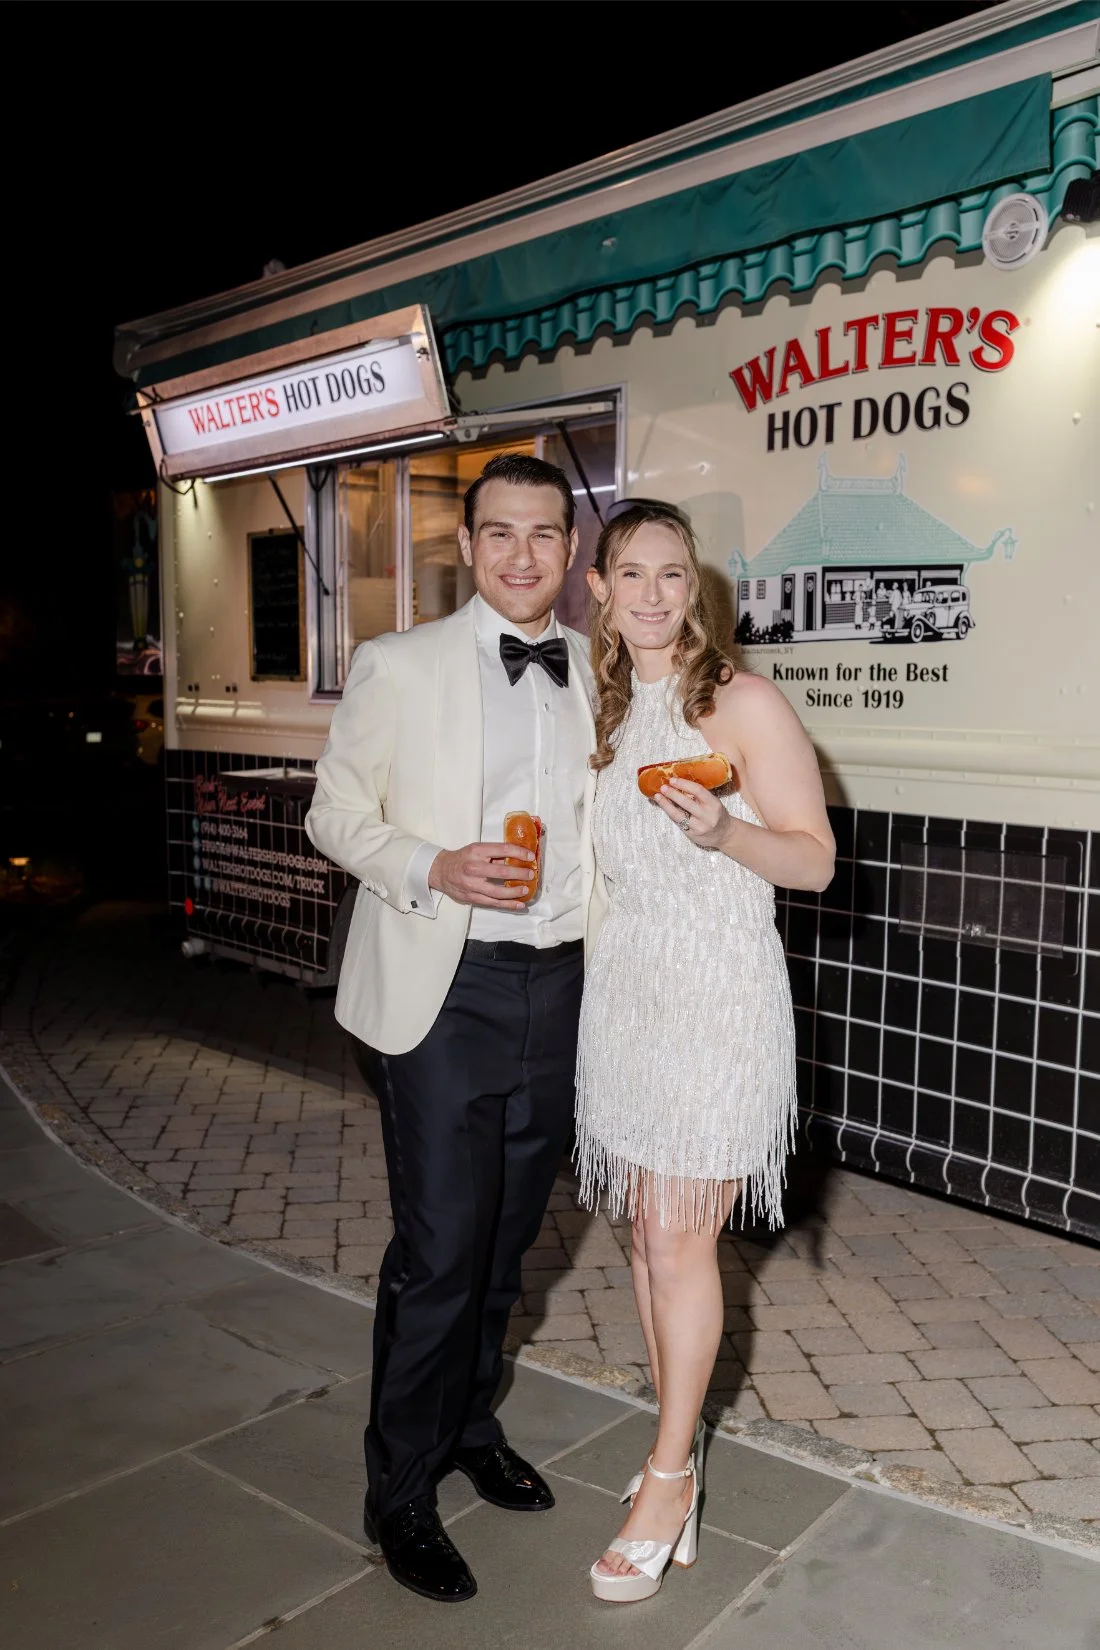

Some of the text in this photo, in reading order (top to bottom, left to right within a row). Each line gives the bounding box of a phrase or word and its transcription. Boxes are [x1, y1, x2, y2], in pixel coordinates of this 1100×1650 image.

[729, 306, 1021, 413] WALTER'S
[188, 361, 386, 436] WALTER'S HOT DOGS
[766, 382, 970, 453] HOT DOGS
[773, 662, 949, 682] Known for the Best
[805, 689, 904, 709] Since 1919
[202, 858, 325, 893] WALTERSHOTDOGS.COM/TRUCK
